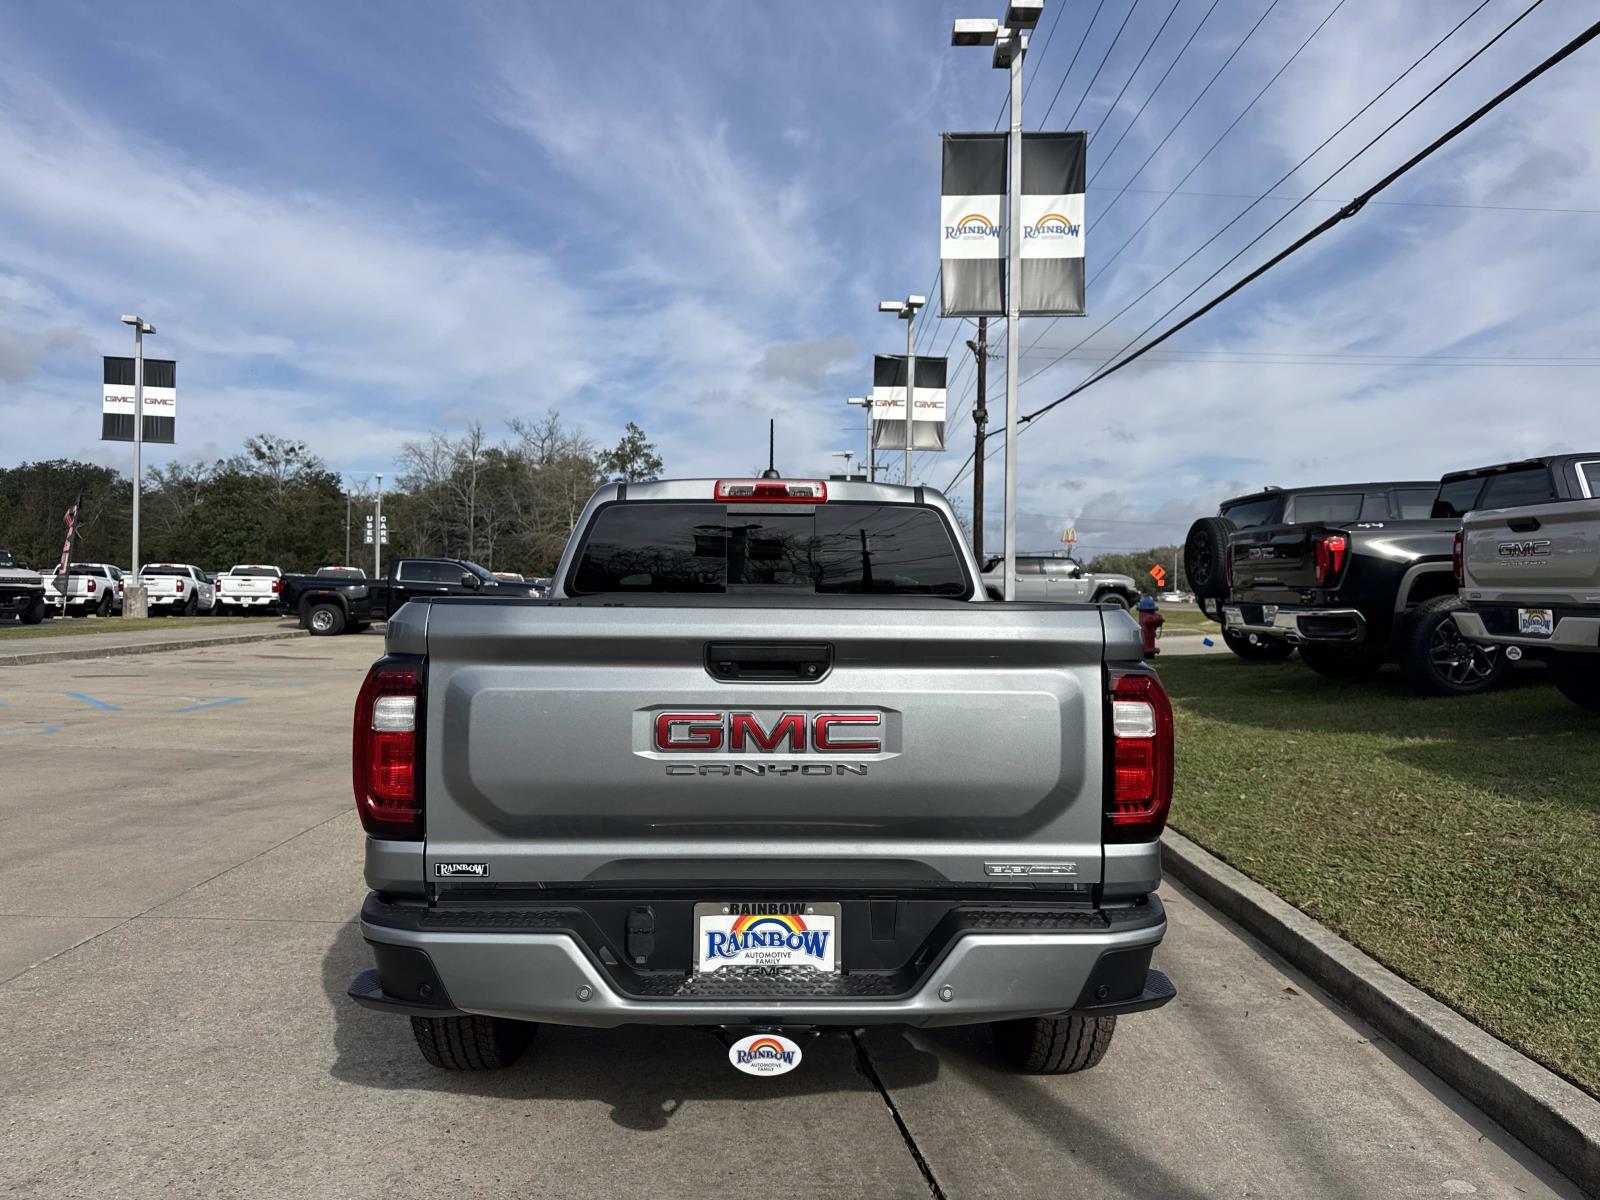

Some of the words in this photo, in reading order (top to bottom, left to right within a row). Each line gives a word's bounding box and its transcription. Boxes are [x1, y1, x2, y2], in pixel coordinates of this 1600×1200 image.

[945, 225, 1002, 240] RAINBOW
[1023, 224, 1080, 239] RAINBOW
[105, 395, 135, 404] GMC
[144, 397, 174, 406] GMC
[875, 399, 905, 407] GMC
[914, 400, 944, 409] GMC
[1498, 540, 1551, 557] GMC
[654, 711, 881, 754] GMC
[666, 763, 868, 777] CANYON
[440, 863, 484, 876] RAINBOW
[729, 902, 806, 915] RAINBOW
[705, 929, 829, 961] RAINBOW
[744, 951, 791, 959] AUTOMOTIVE
[736, 1050, 795, 1066] RAINBOW
